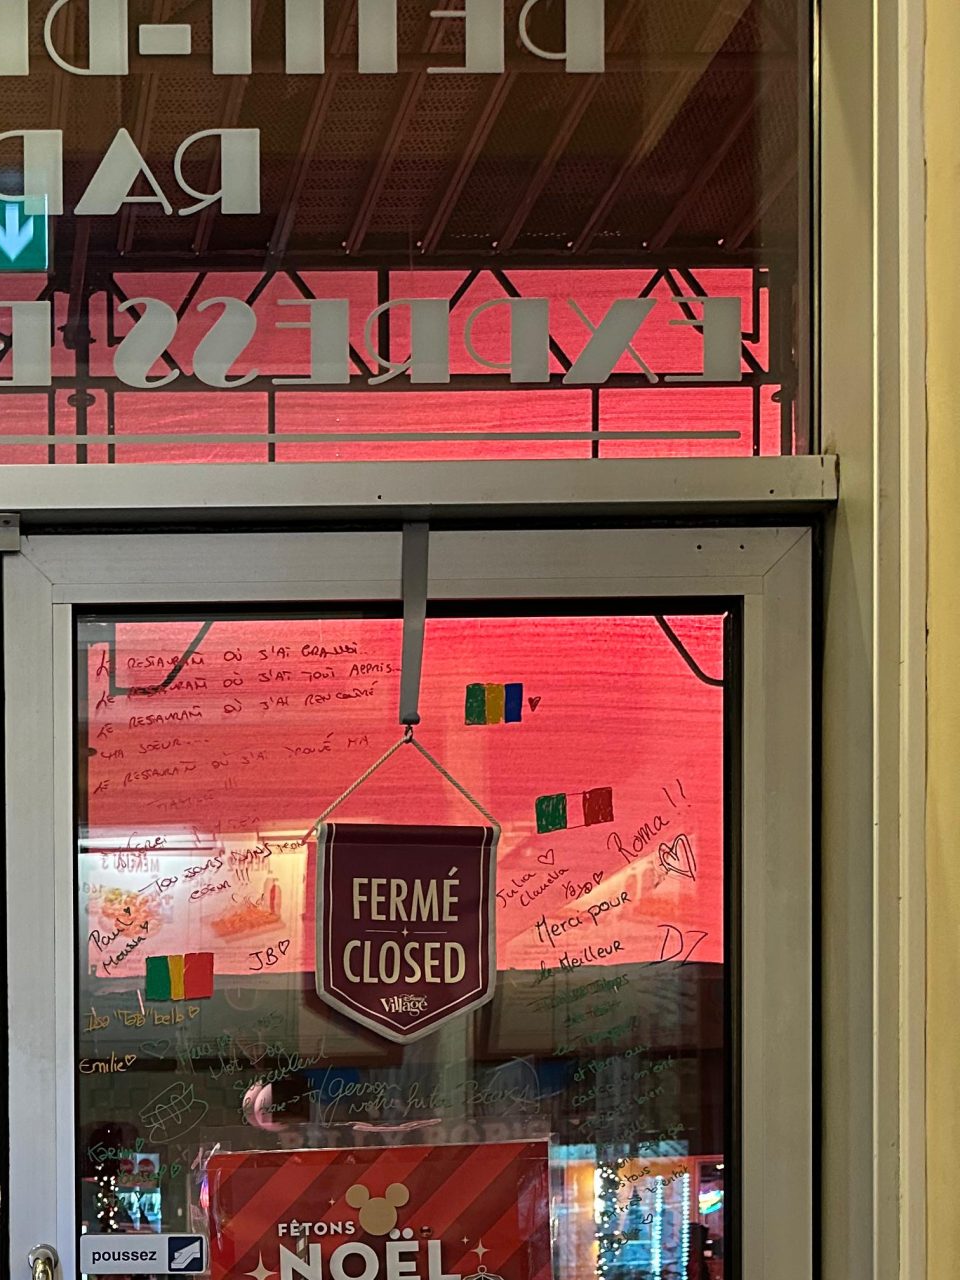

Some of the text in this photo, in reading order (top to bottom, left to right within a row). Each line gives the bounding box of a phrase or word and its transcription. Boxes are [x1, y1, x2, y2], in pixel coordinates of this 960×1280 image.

[352, 866, 460, 922] FERMÉ
[535, 911, 582, 948] Merci
[343, 940, 466, 984] CLOSED
[379, 995, 428, 1016] Village
[79, 1050, 126, 1074] Emilie
[279, 1219, 356, 1236] FÊTONS
[92, 1249, 157, 1265] poussez
